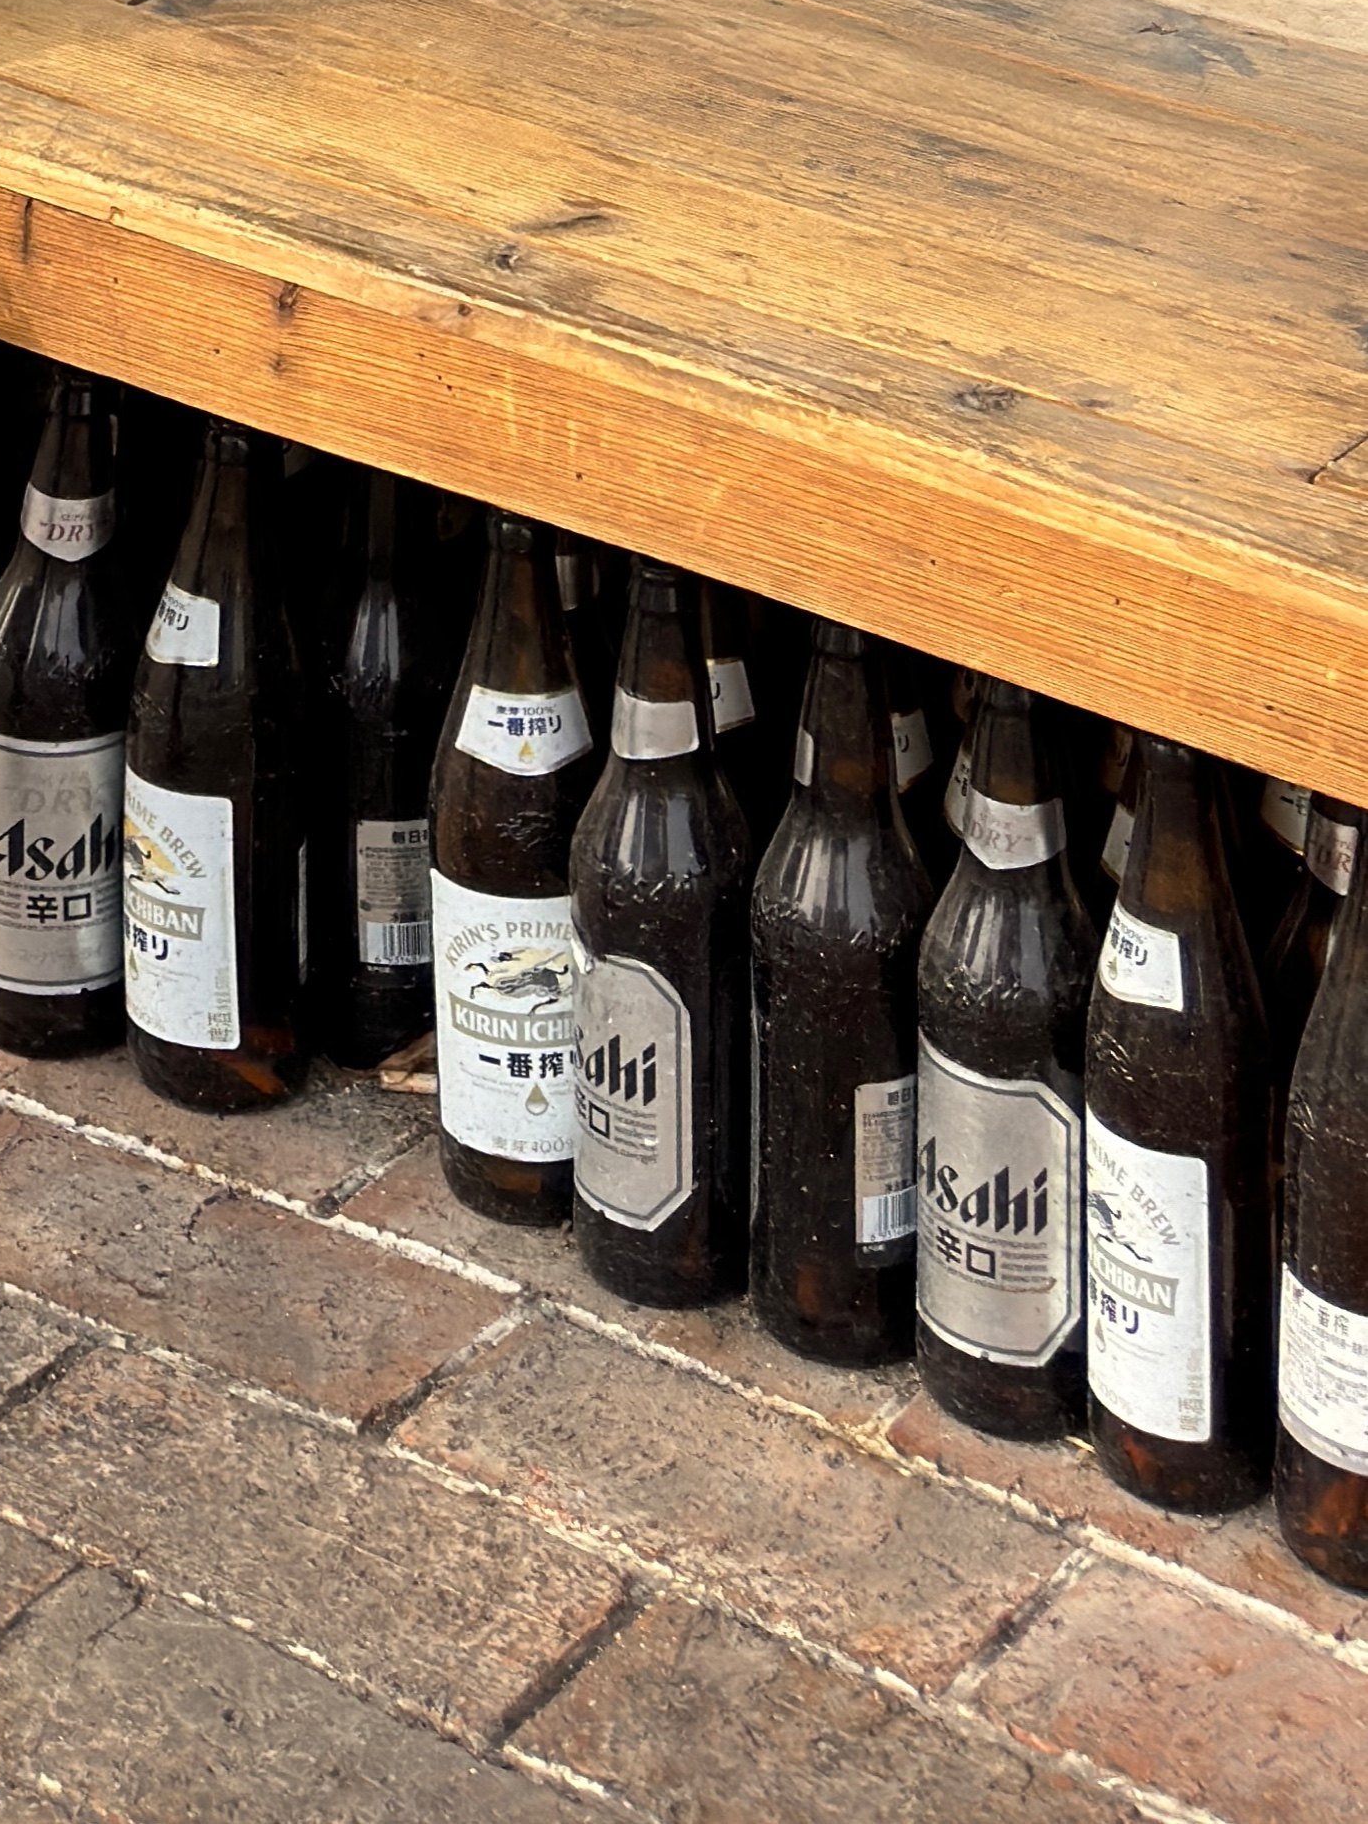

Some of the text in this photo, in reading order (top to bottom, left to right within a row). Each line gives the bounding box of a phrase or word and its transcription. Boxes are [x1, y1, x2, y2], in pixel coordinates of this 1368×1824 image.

[487, 714, 563, 737] 一番搾り
[522, 705, 556, 716] 100%
[160, 825, 207, 881] BREW
[26, 893, 92, 923] 辛口
[445, 921, 501, 967] KIRIN'S
[455, 1003, 518, 1041] KIRIN
[919, 1135, 1048, 1236] Asahi
[1130, 1184, 1181, 1246] BREW
[936, 1225, 996, 1280] 辛口
